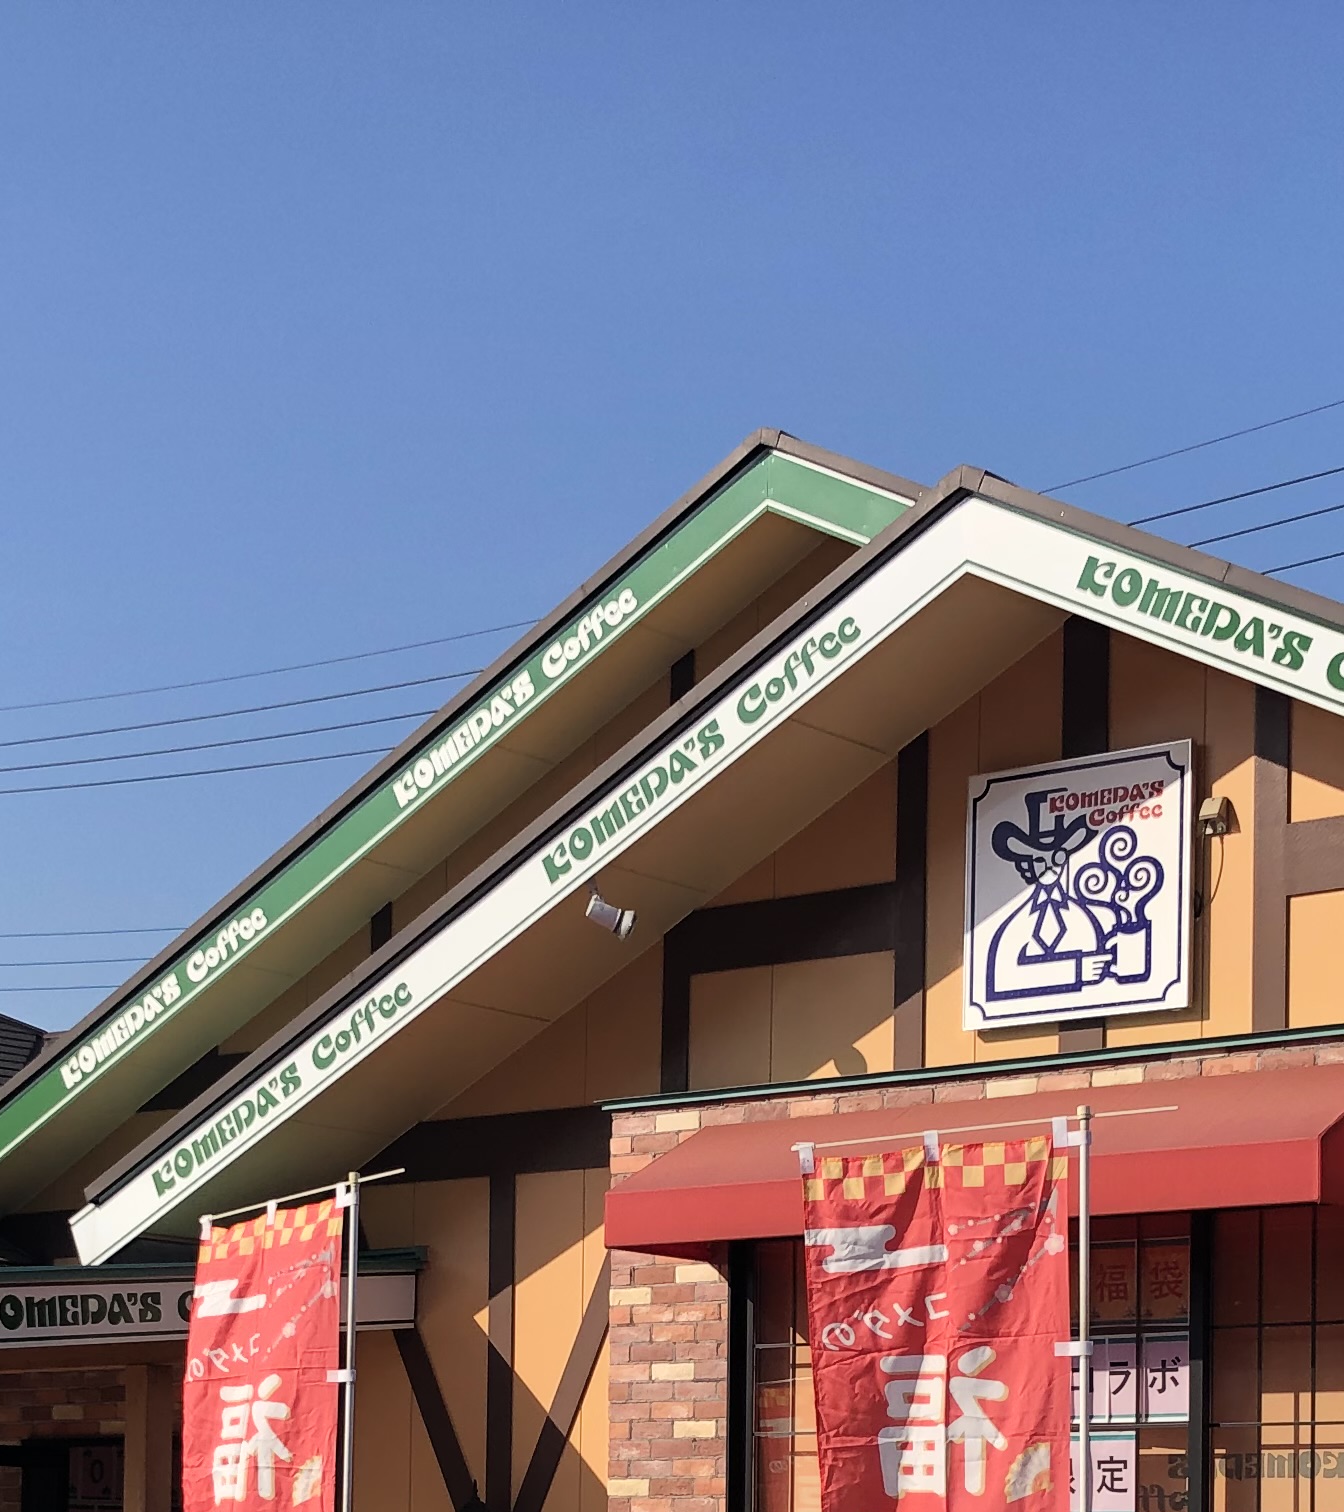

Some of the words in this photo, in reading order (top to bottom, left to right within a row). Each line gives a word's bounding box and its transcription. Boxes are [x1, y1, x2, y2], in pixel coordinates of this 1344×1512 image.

[1077, 555, 1313, 673] KOMEDA'S
[393, 675, 536, 808] KOMEDA'S
[541, 588, 638, 681] Coffee
[542, 717, 727, 885] KOMEDA'S
[736, 616, 862, 725] Coffee
[1048, 780, 1165, 815] KOMEDA'S
[1088, 802, 1163, 827] Coffee
[62, 977, 182, 1089] KOMEDA'S
[187, 906, 268, 984] Coffee
[151, 1062, 303, 1198] KOMEDA'S
[312, 981, 414, 1071] Coffee
[1096, 1260, 1184, 1302] 福袋
